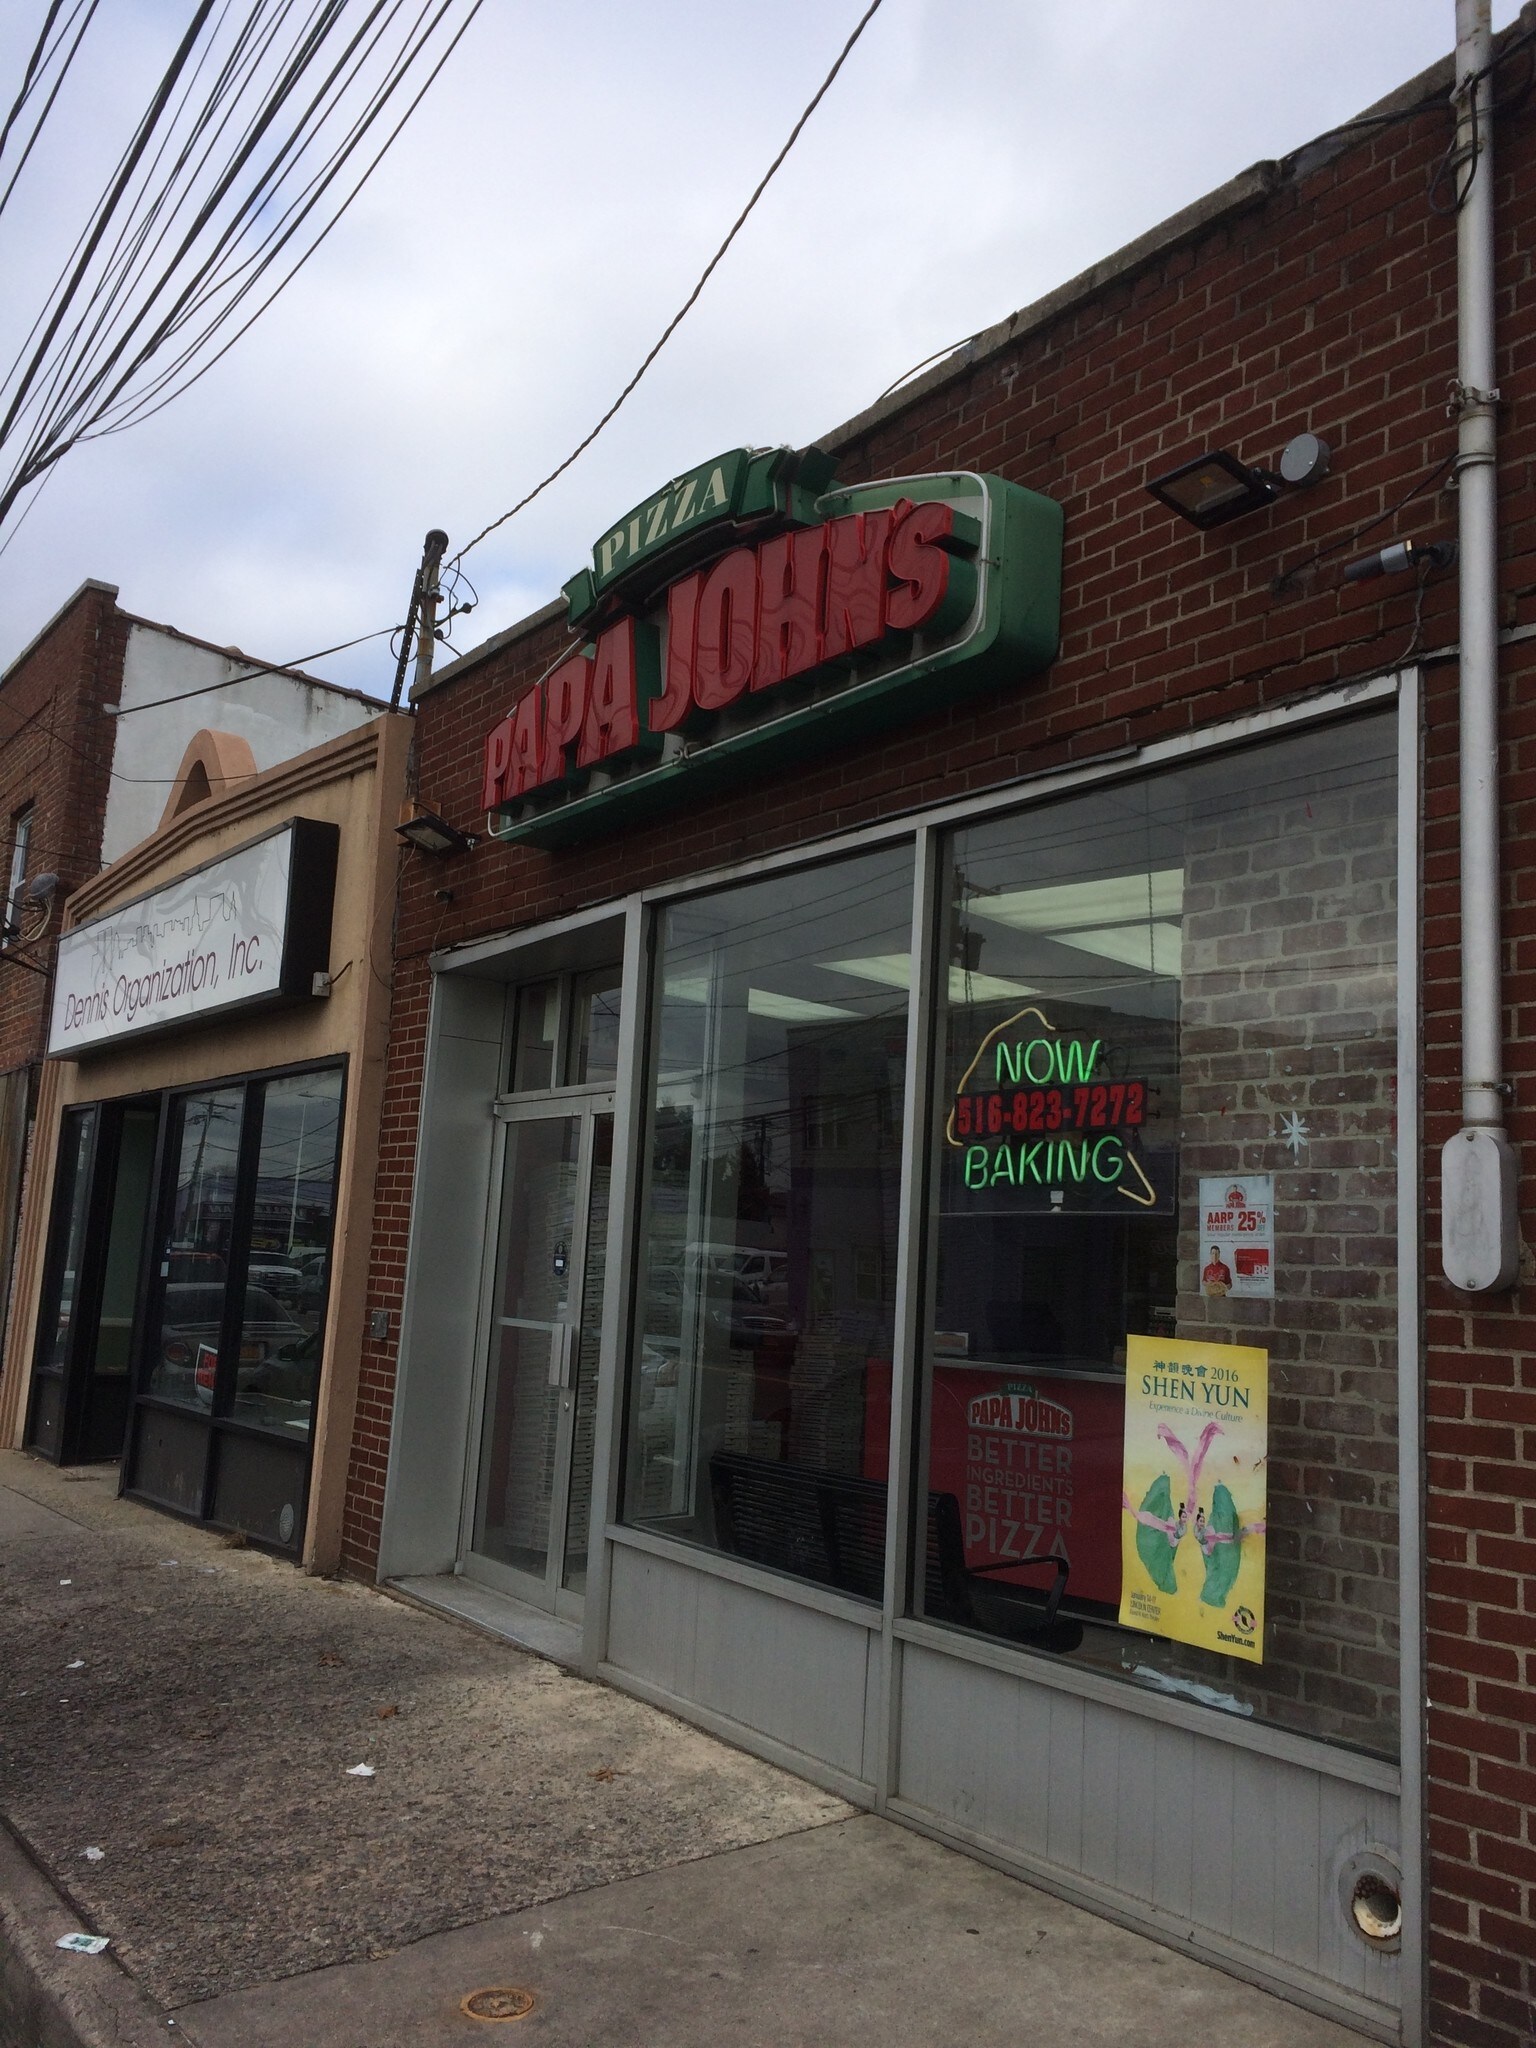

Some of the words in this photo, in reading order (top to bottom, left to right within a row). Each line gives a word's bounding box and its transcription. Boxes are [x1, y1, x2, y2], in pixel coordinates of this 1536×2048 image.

[600, 467, 728, 577] PIZZA
[483, 615, 636, 810] PAPA
[649, 498, 953, 732] JOHN'S
[64, 983, 109, 1031] Dennis
[113, 949, 219, 1022] Organization,
[228, 934, 263, 980] Inc.
[996, 1039, 1101, 1084] NOW
[958, 1083, 1144, 1134] 516-823-7272
[965, 1136, 1123, 1189] BAKING
[1207, 1212, 1234, 1224] AARP
[1238, 1210, 1266, 1231] 25%
[1142, 1375, 1195, 1401] SHEN
[1202, 1382, 1250, 1408] YUN
[1153, 1360, 1208, 1378] 神韻晚會
[1211, 1367, 1239, 1382] 2016
[972, 1397, 1012, 1428] PAPA
[1149, 1400, 1184, 1415] Experience
[1215, 1410, 1243, 1423] Culture
[967, 1434, 1073, 1475] BETTER
[966, 1465, 1074, 1497] INGREDIENTS
[966, 1483, 1072, 1528] BETTER
[965, 1512, 1071, 1568] PIZZA
[1217, 1630, 1255, 1648] ShenYun.com
